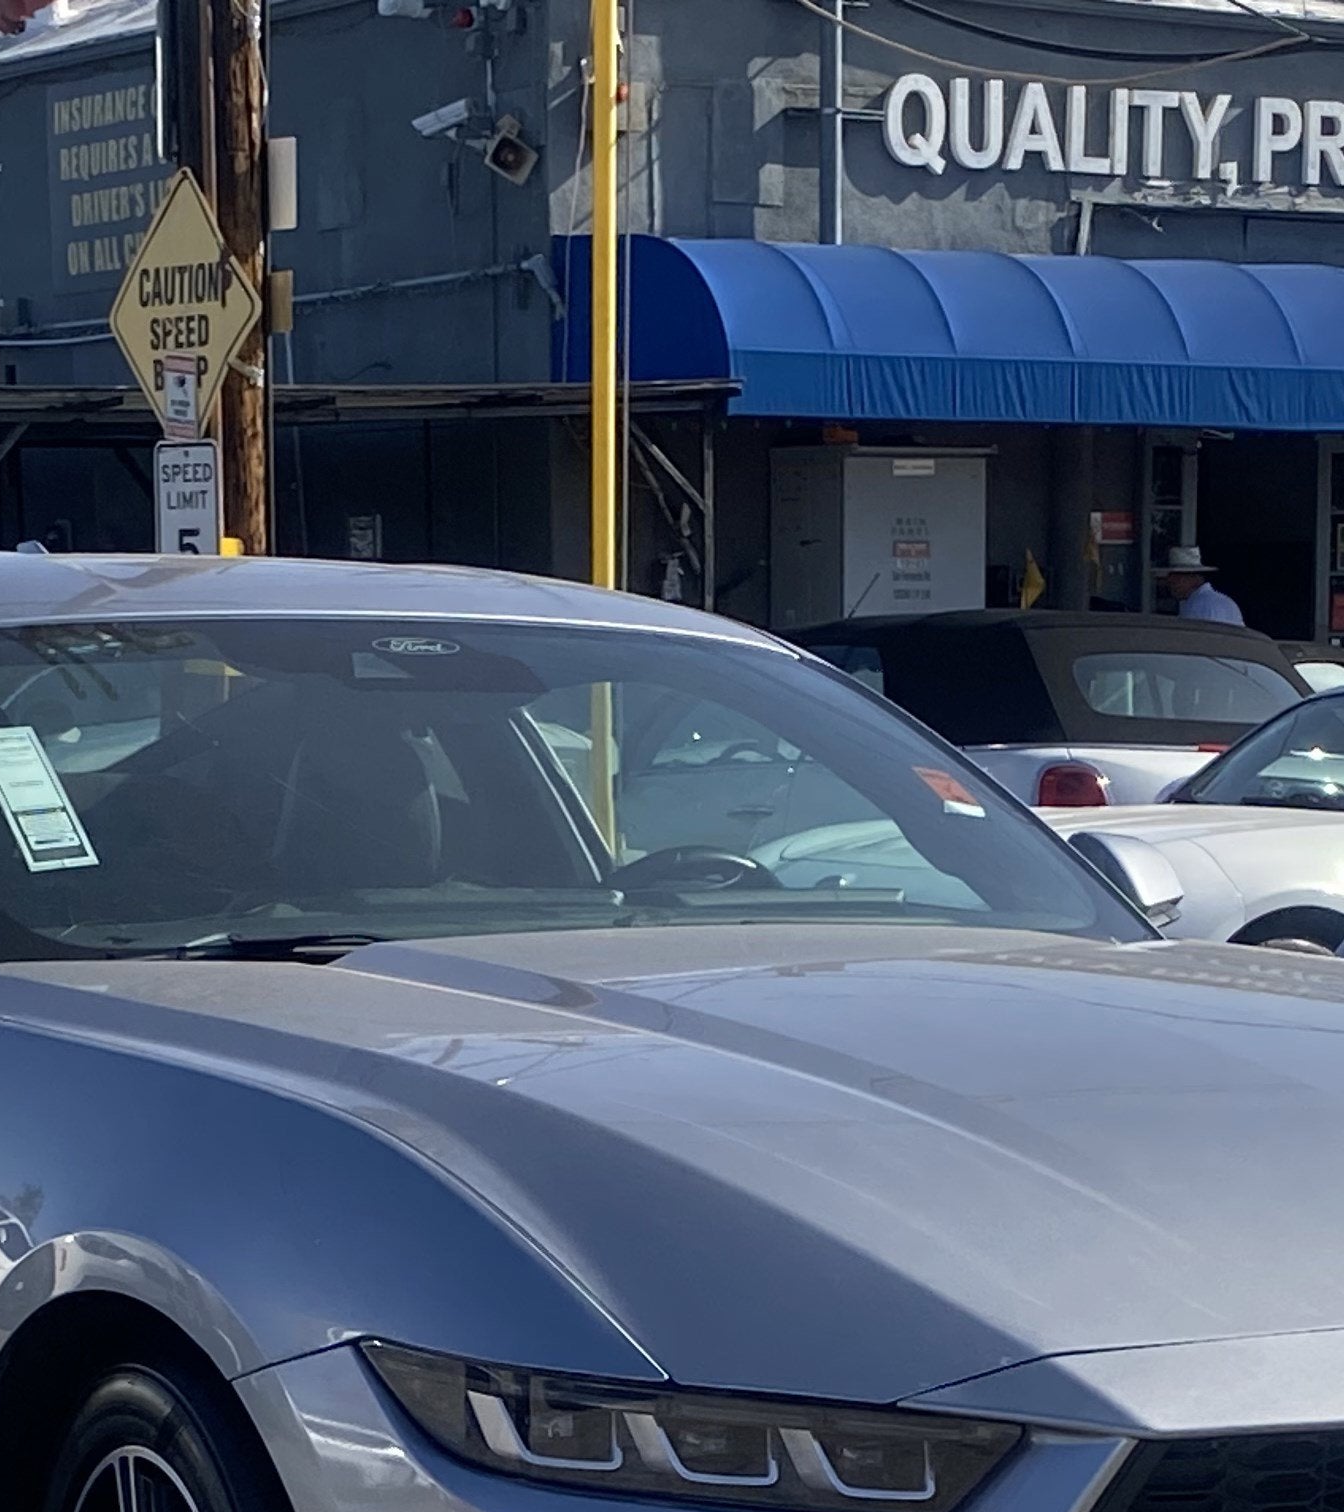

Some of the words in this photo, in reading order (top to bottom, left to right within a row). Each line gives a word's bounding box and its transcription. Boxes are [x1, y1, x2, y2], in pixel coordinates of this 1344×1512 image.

[53, 84, 147, 135] INSURANCE
[882, 73, 1240, 197] QUALITY,
[60, 135, 138, 181] REQUIRES
[141, 132, 154, 167] A
[71, 182, 146, 227] DRIVER'S
[67, 240, 90, 276] ON
[94, 236, 122, 272] ALL
[139, 262, 223, 308] CAUTION
[150, 314, 210, 351] SPEED
[153, 355, 209, 391] BP
[161, 462, 213, 483] SPEED
[166, 490, 208, 509] LIMIT
[178, 527, 201, 555] 5
